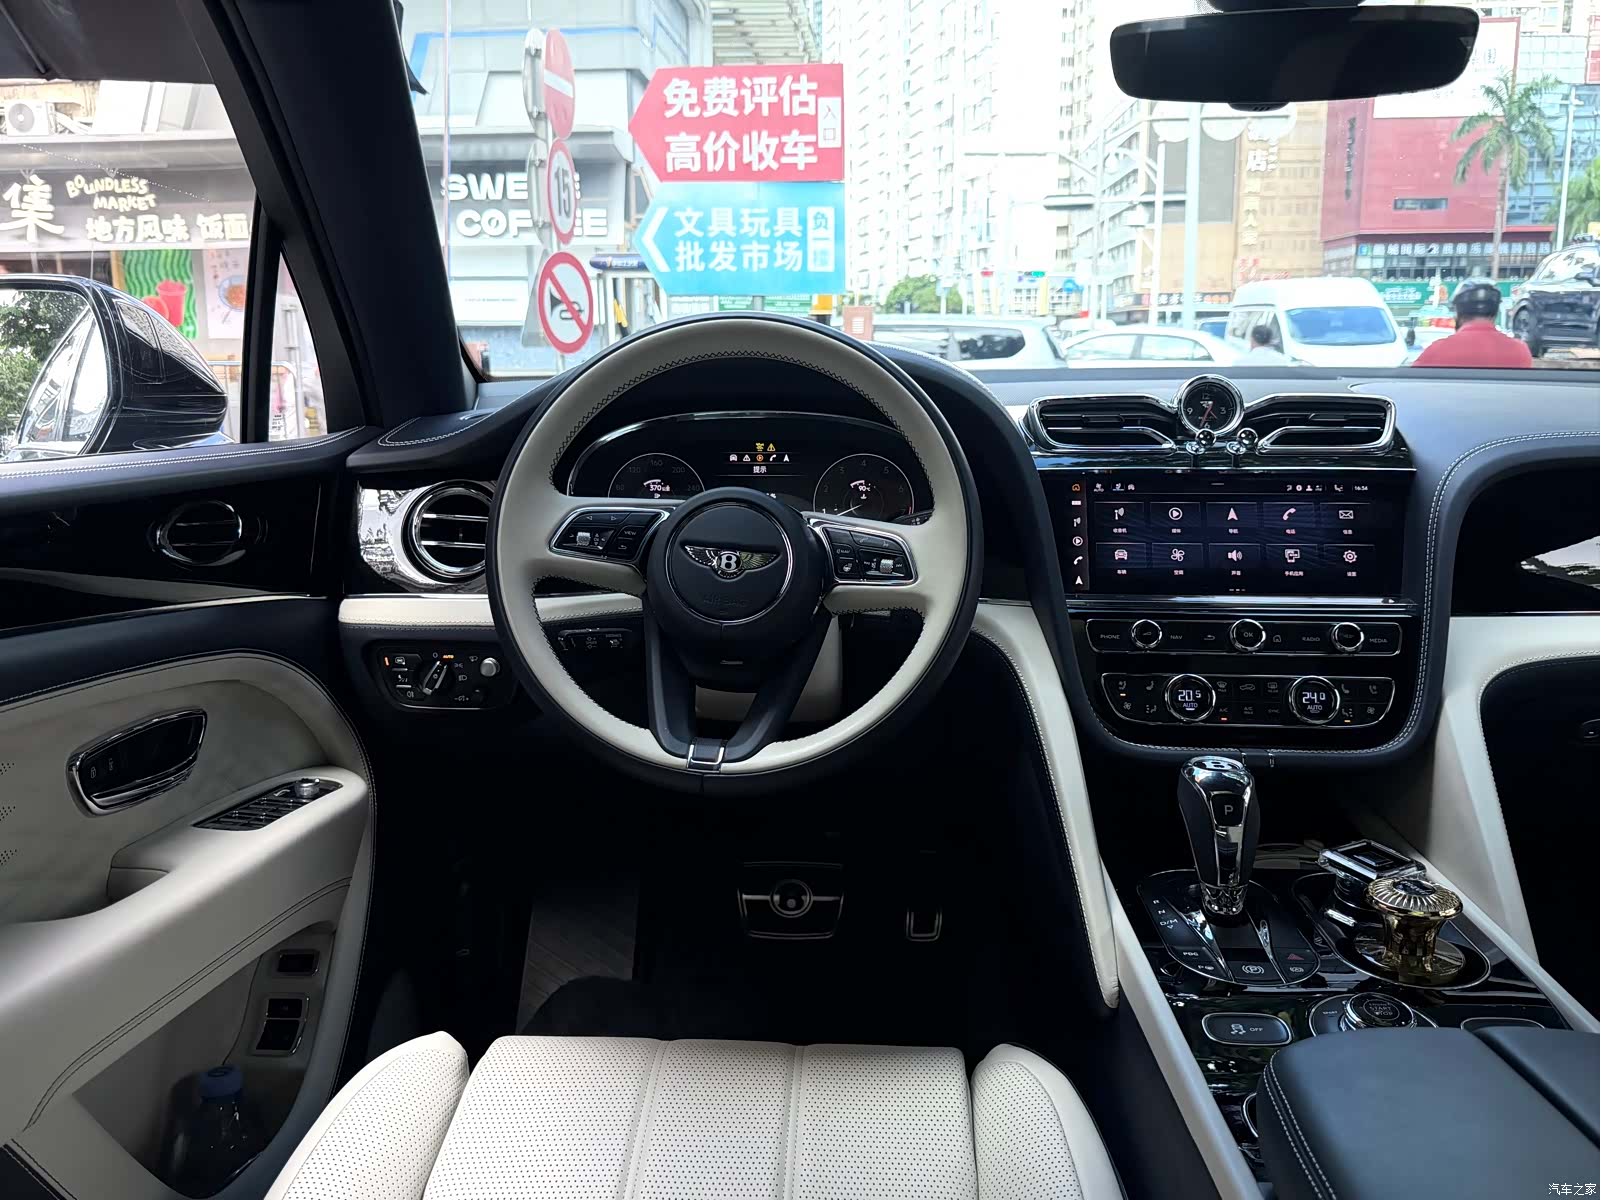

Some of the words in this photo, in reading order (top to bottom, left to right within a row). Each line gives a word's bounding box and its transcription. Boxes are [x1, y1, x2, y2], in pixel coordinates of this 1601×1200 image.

[663, 74, 819, 119] 免费评估
[823, 104, 837, 141] 入口
[664, 130, 819, 173] 高价收车
[65, 174, 150, 198] BOUNDLESS
[441, 172, 581, 201] SWE
[555, 166, 572, 218] 15
[93, 194, 157, 212] MARKET
[86, 214, 190, 243] 地方风味
[456, 208, 608, 237] COFE
[674, 207, 803, 238] 文具玩具
[674, 240, 803, 272] 批发市场
[1186, 407, 1193, 415] 9
[1219, 406, 1227, 415] 3
[752, 465, 767, 474] 提示
[1178, 689, 1202, 702] 20.5
[1302, 691, 1326, 704] 24.0
[1224, 804, 1234, 816] P
